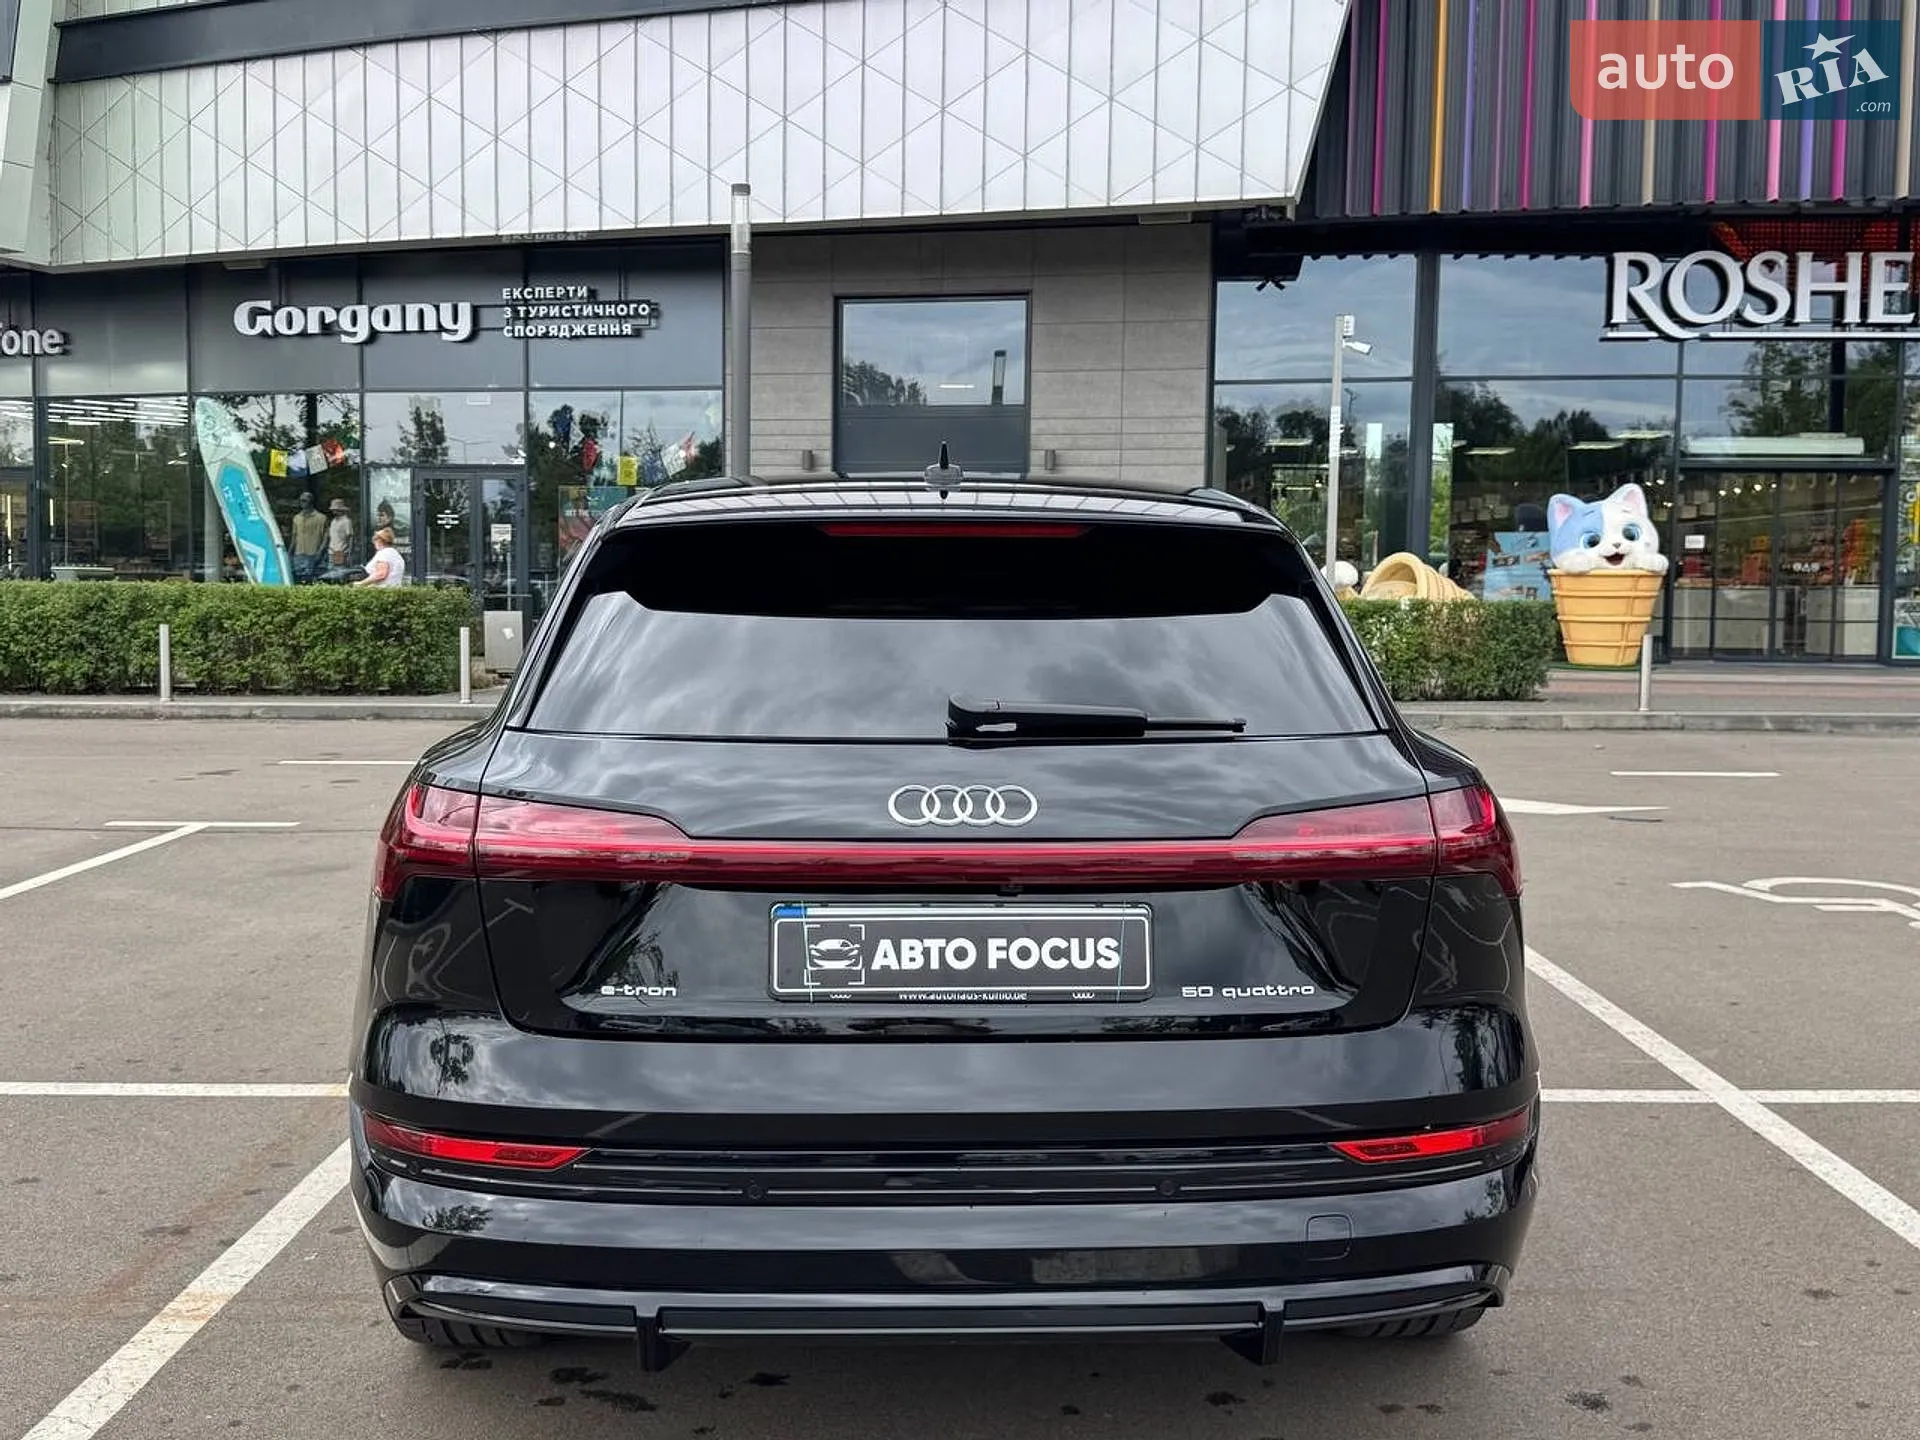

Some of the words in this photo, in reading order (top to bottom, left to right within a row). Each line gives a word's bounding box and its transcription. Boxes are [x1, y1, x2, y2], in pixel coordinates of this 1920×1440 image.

[502, 286, 588, 300] ЕКСПЕРТИ
[518, 303, 650, 318] ТУРИСТИЧНОГО
[233, 301, 472, 344] Gorgany
[503, 323, 633, 338] СПОРЯДЖЕННЯ
[0, 323, 63, 355] one
[987, 938, 1122, 970] FOCUS
[601, 985, 677, 997] e-tron
[1181, 985, 1214, 998] 50
[1221, 985, 1315, 999] quattro
